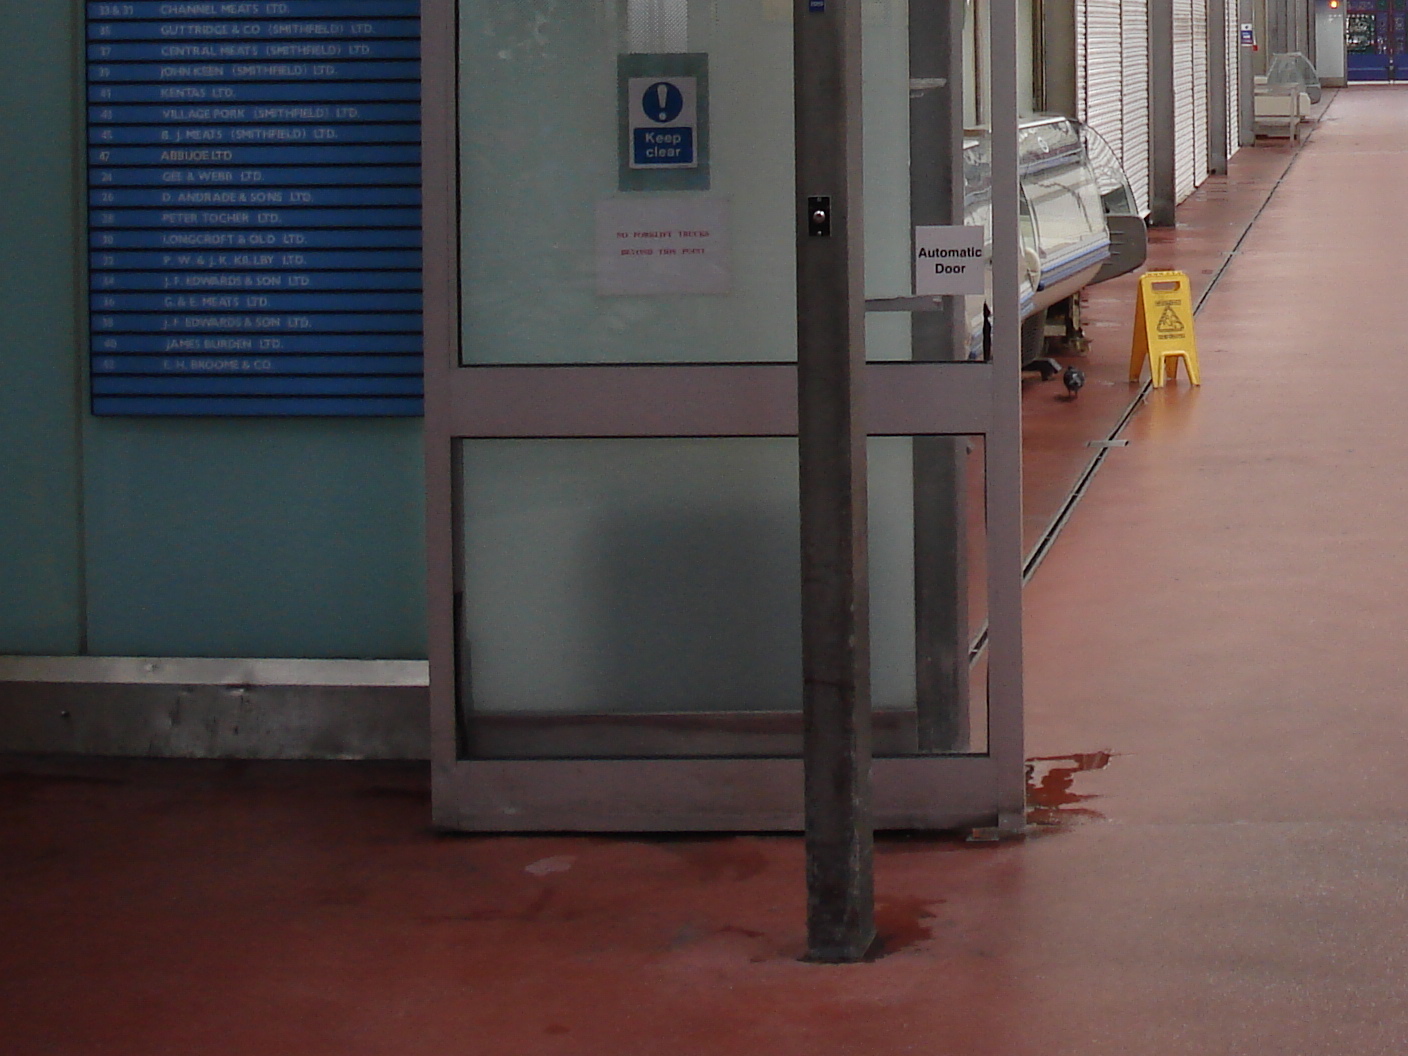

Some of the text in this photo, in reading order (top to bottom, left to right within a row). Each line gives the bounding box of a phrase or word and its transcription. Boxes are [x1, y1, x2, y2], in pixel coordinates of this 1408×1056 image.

[160, 4, 218, 14] CHANNEL
[221, 4, 259, 14] MEATS
[161, 46, 217, 56] CENTRAL
[220, 45, 258, 56] MEATS
[162, 109, 210, 119] VILLAGE
[213, 109, 245, 119] PORK
[185, 130, 222, 140] MEATS
[645, 132, 681, 146] Keep
[211, 150, 233, 161] LTD
[645, 146, 681, 158] clear
[177, 192, 236, 202] ANDRADE
[161, 213, 198, 223] PETER
[202, 213, 249, 223] TOCHER
[162, 234, 234, 244] LONGCROFT
[249, 234, 276, 244] OLD
[918, 247, 982, 258] Automatic
[935, 263, 966, 274] Door
[186, 276, 242, 286] EDWARDS
[256, 276, 282, 286] SON
[202, 297, 239, 307] MEATS
[185, 317, 242, 328] EDWARDS
[255, 317, 280, 328] SON
[166, 339, 201, 351] JAMES
